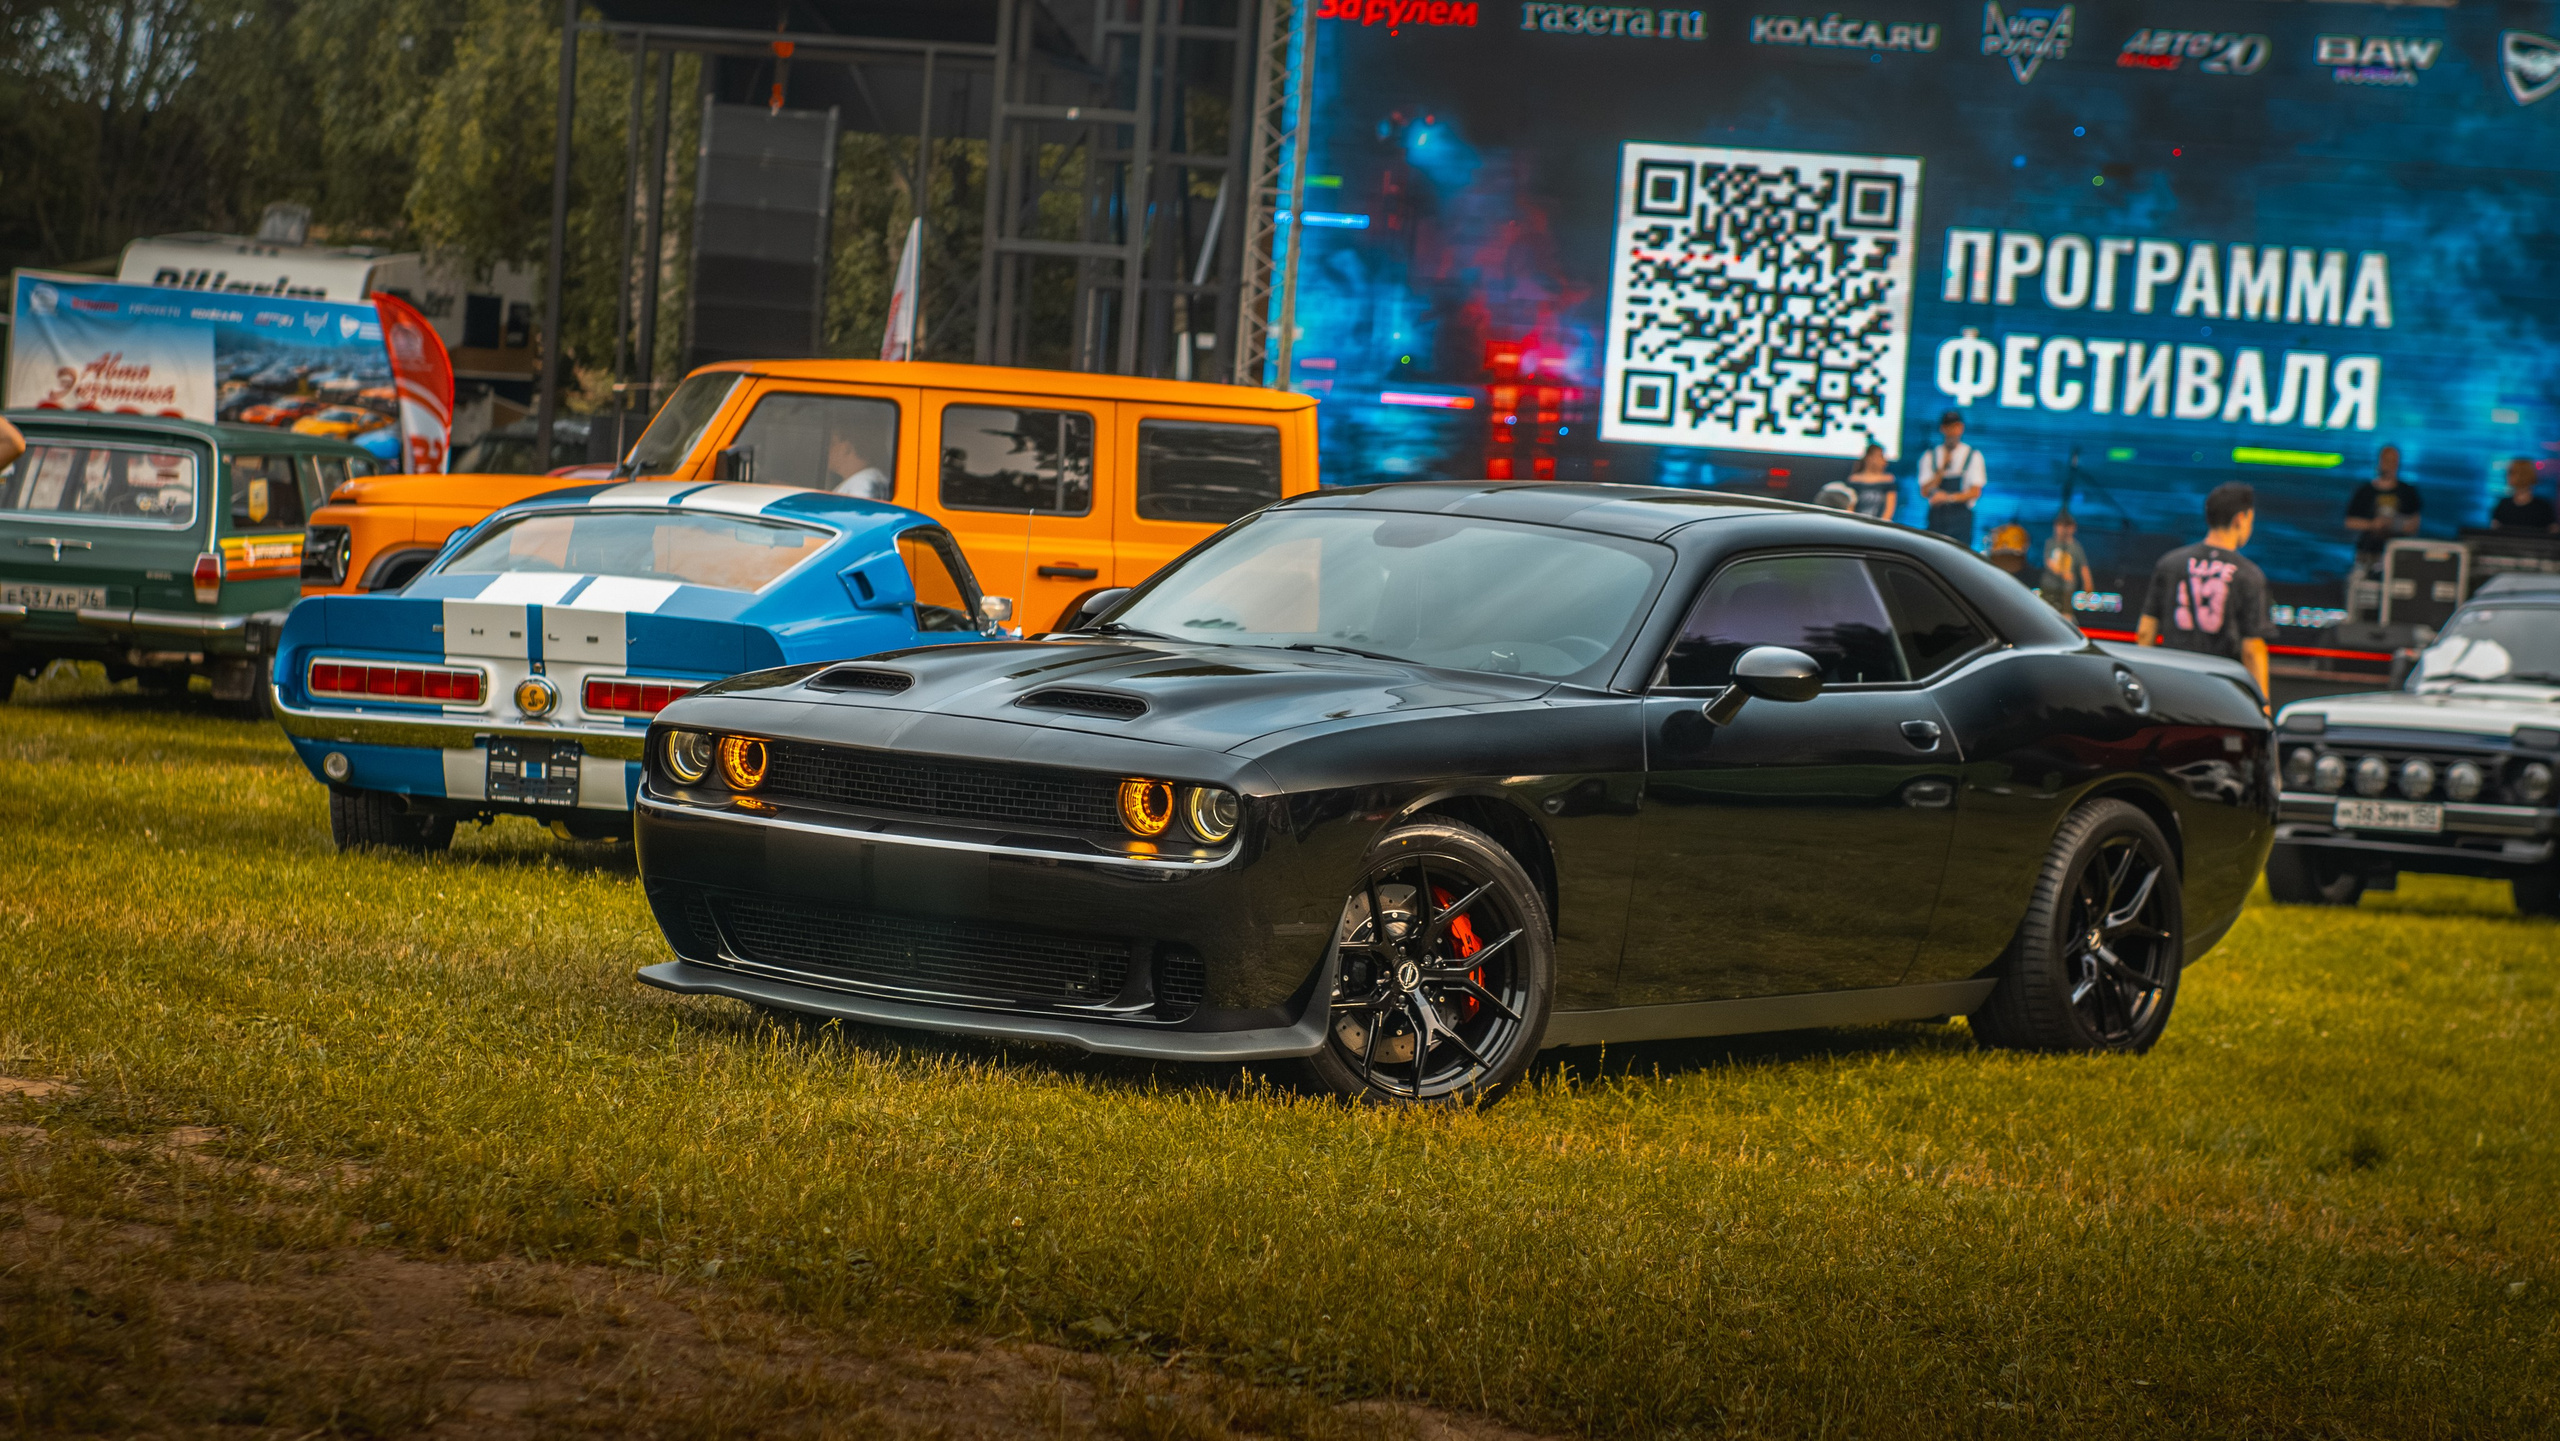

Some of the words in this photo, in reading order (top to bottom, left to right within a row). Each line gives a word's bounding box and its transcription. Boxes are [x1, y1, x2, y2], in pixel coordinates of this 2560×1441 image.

[2122, 28, 2215, 57] АВТО
[2200, 33, 2272, 75] 20
[2314, 32, 2443, 70] BAW
[1940, 226, 2394, 330] ПРОГРАММА
[1934, 325, 2383, 432] ФЕСТИВАЛЯ
